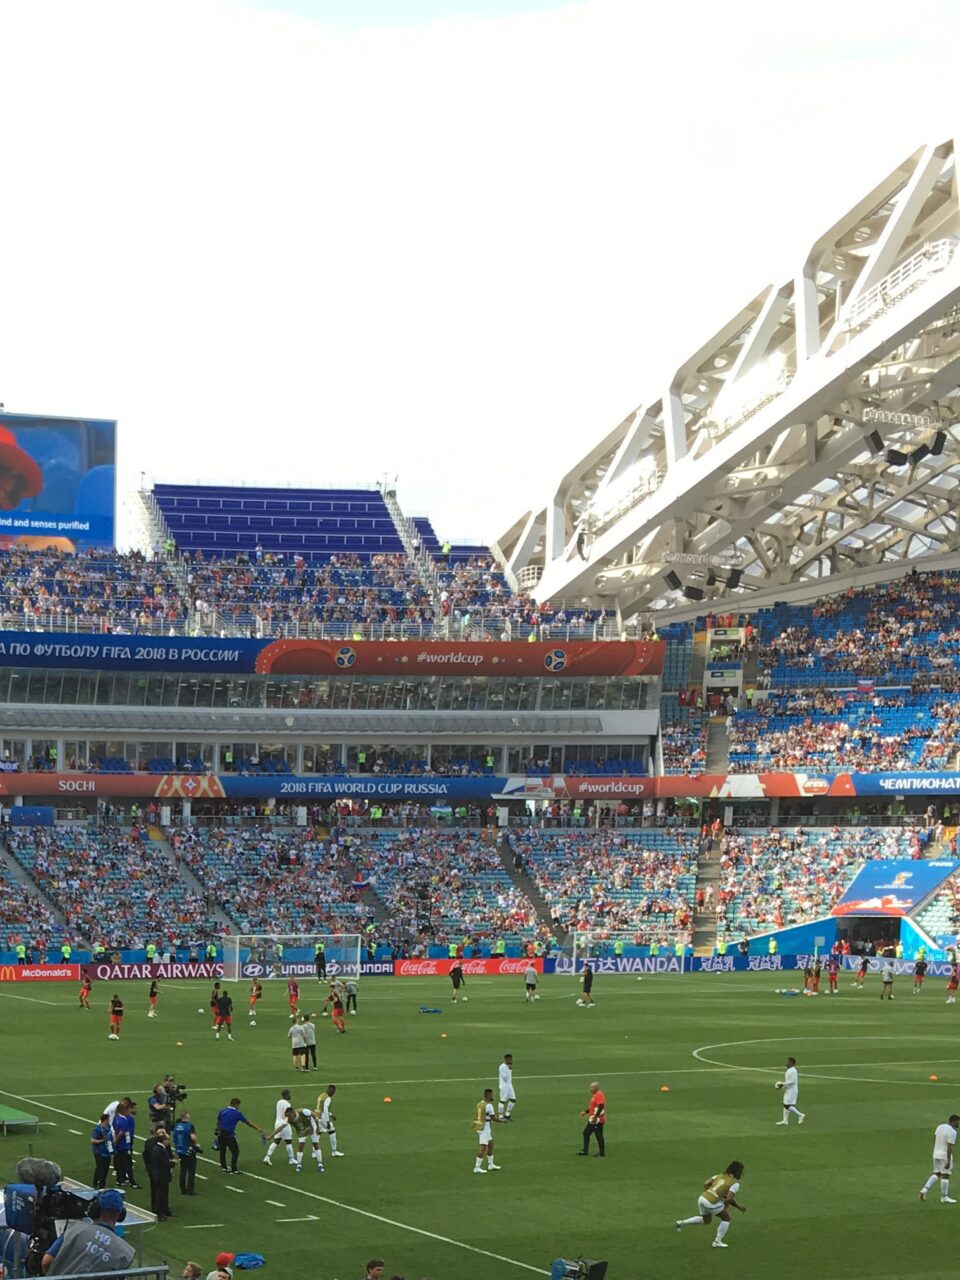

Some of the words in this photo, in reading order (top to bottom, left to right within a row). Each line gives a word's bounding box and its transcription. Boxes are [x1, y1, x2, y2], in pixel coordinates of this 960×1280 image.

[13, 518, 29, 528] and
[30, 520, 57, 529] senses
[58, 519, 90, 531] purified
[9, 643, 31, 656] ПО
[33, 644, 100, 658] ФУТБОЛУ
[102, 646, 132, 659] FIFA
[134, 647, 166, 660] 2018
[181, 648, 240, 662] РОССИИ
[416, 651, 484, 668] #worldcup
[58, 779, 96, 792] SOCHI
[280, 782, 307, 793] 2018
[308, 782, 333, 793] FIFA
[334, 782, 376, 793] WORLD
[377, 783, 403, 794] CUP
[404, 783, 448, 794] RUSSIA
[578, 781, 644, 795] #worldcup
[343, 963, 393, 973] HYUNDAI
[617, 957, 680, 972] WANDA
[21, 969, 73, 978] McDonald's
[97, 964, 152, 980] QATAR
[156, 963, 224, 979] AIRWAYS
